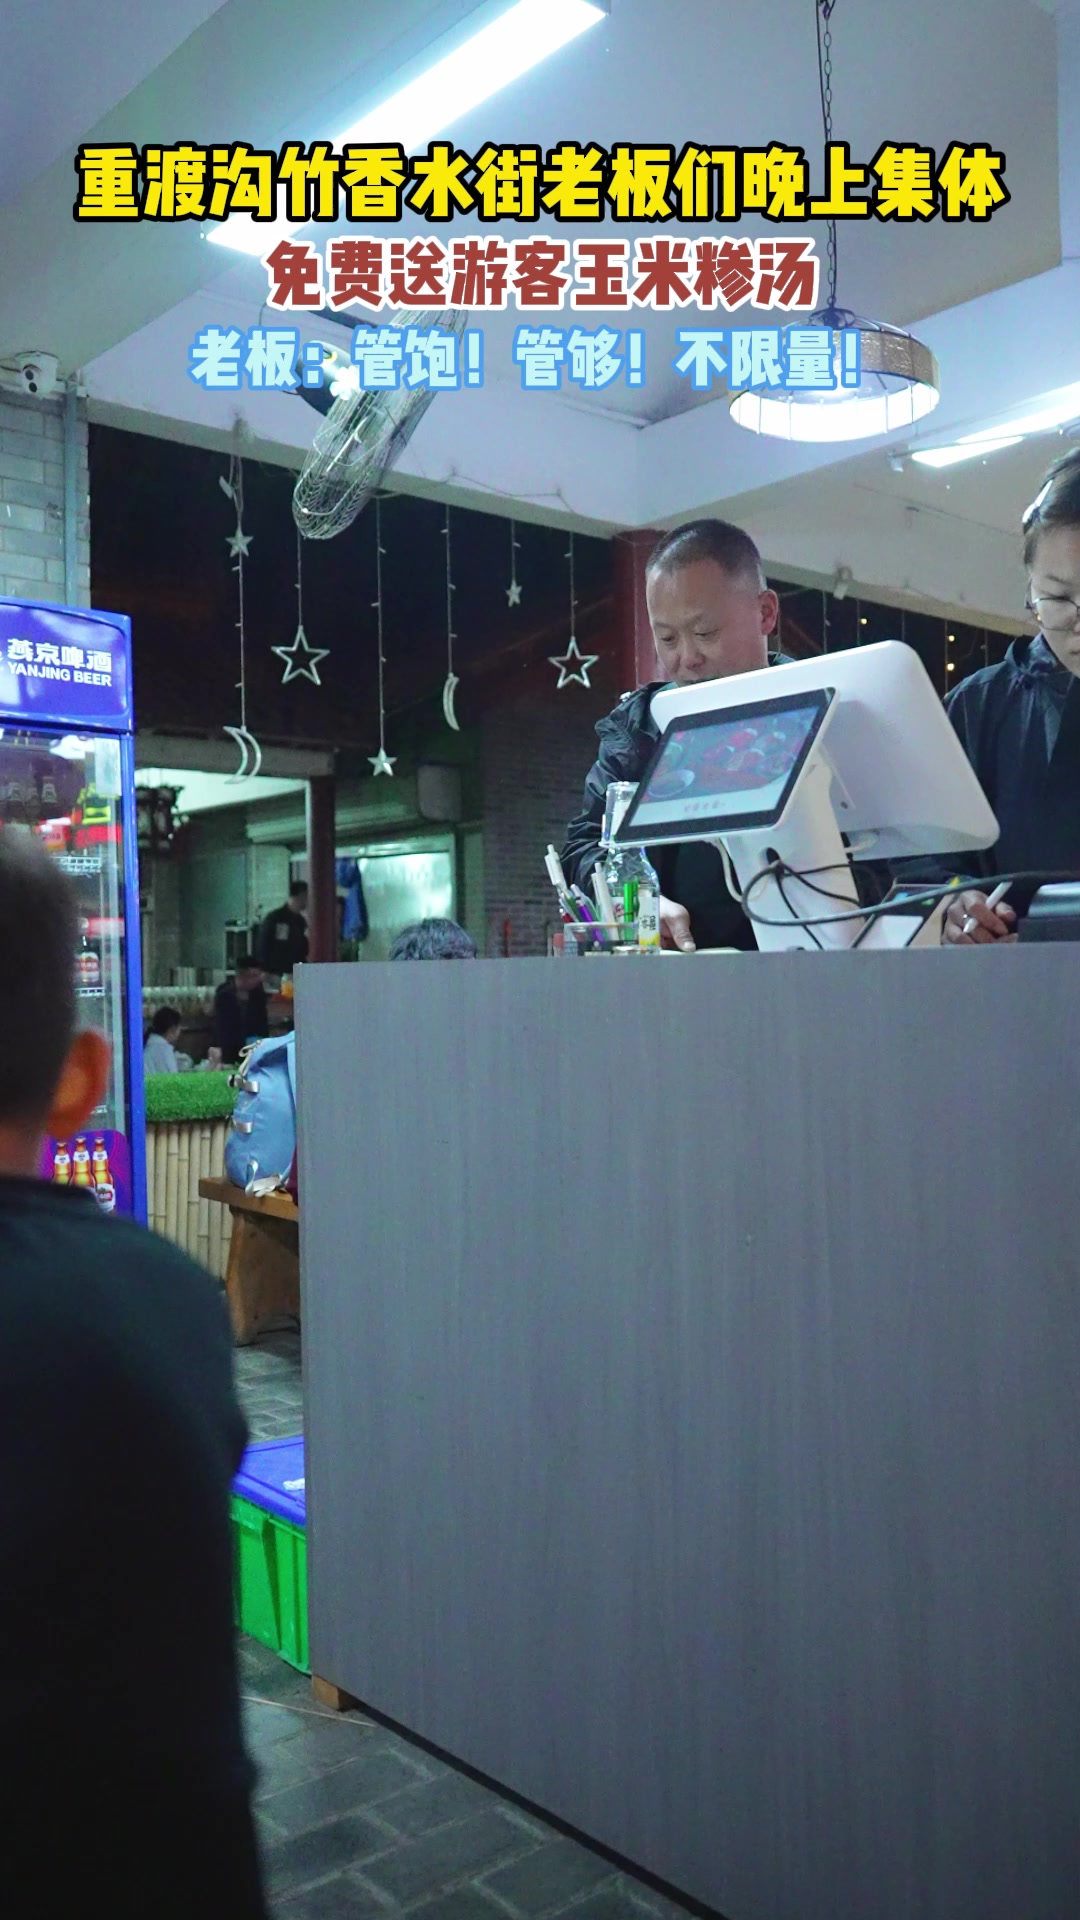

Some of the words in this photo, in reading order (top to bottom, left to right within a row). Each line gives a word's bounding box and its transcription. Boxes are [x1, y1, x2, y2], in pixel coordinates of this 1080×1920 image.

[7, 638, 112, 672] 燕京啤酒
[7, 661, 71, 681] YANJING
[73, 670, 112, 687] BEER
